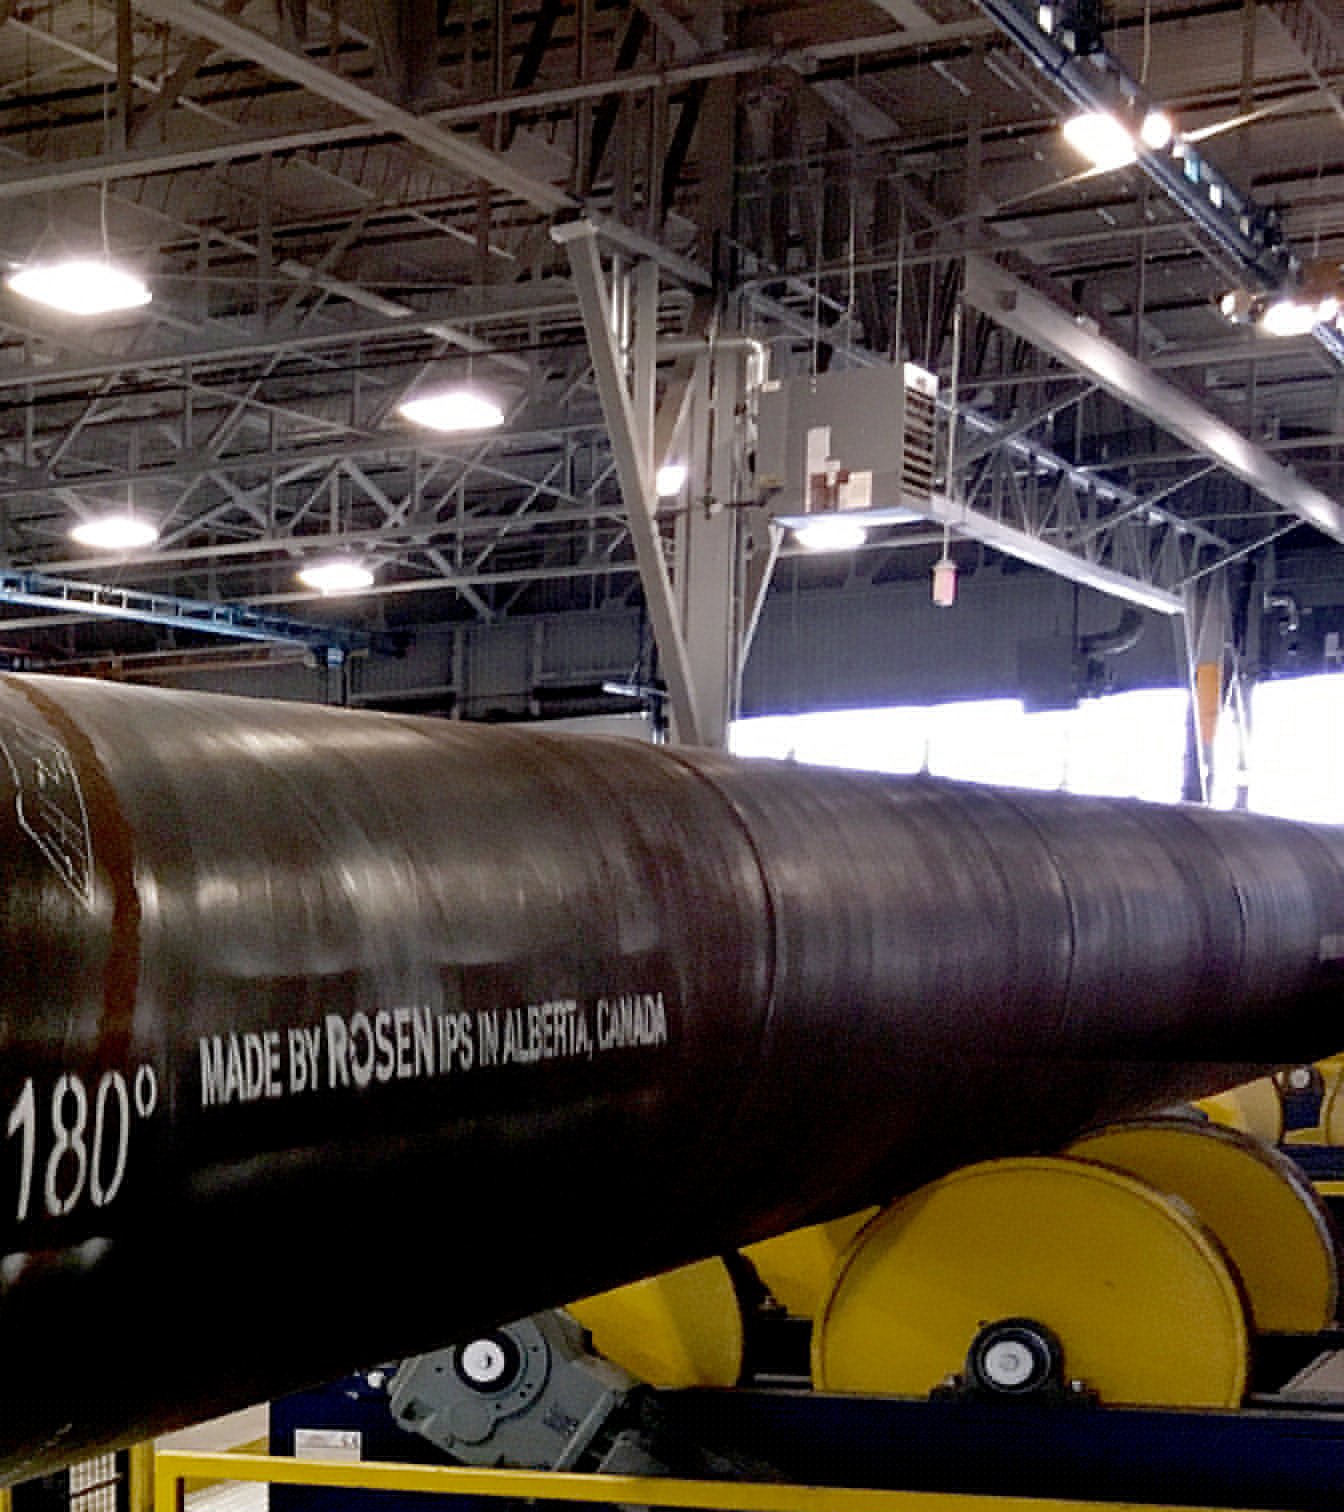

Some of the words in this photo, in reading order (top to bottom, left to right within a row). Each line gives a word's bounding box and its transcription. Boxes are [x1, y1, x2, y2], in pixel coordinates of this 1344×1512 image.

[200, 1033, 283, 1106] MADE
[288, 1026, 321, 1093] BY
[325, 1005, 435, 1087] ROSEN
[438, 1011, 473, 1073] IPS
[478, 1007, 499, 1067] IN
[503, 999, 593, 1062] ALBERTA,
[597, 991, 667, 1050] CANADA
[7, 1063, 157, 1222] 180°
